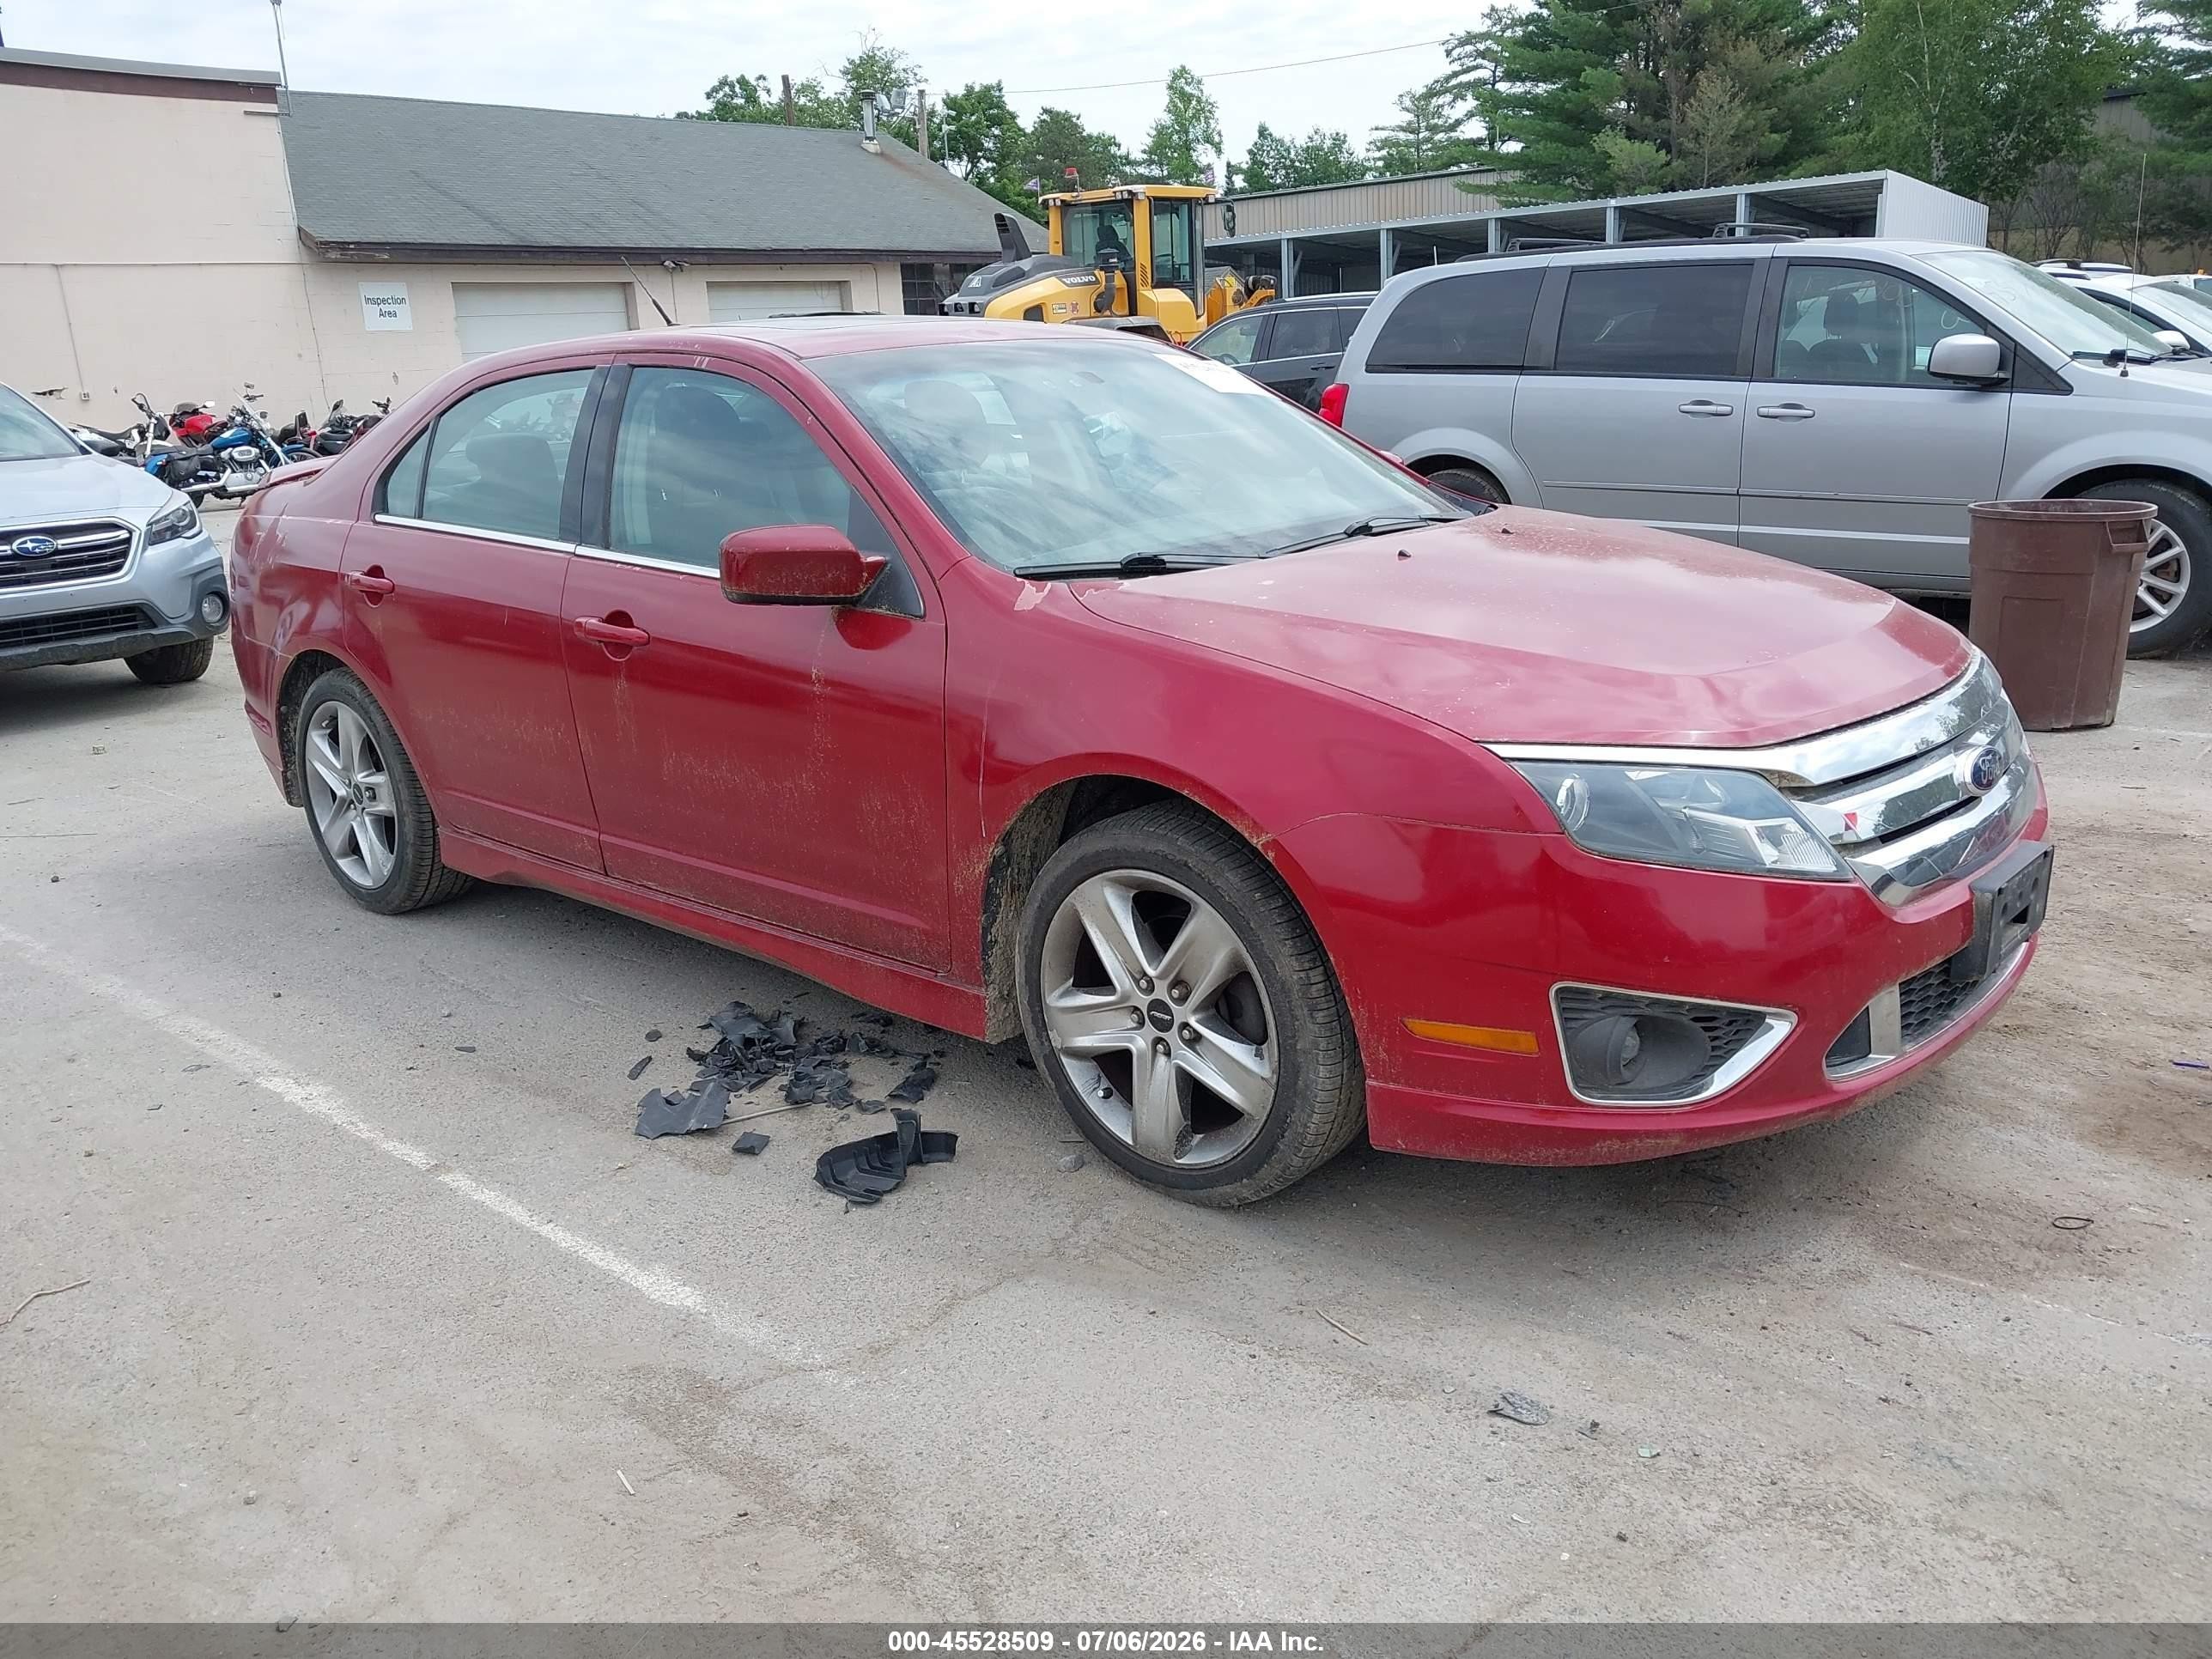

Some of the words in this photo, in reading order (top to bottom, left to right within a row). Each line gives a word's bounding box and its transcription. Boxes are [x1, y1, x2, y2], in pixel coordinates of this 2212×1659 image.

[1063, 276, 1096, 284] VOLVO
[363, 295, 407, 307] Inspection
[379, 307, 398, 318] Area
[1979, 754, 2003, 784] Ford
